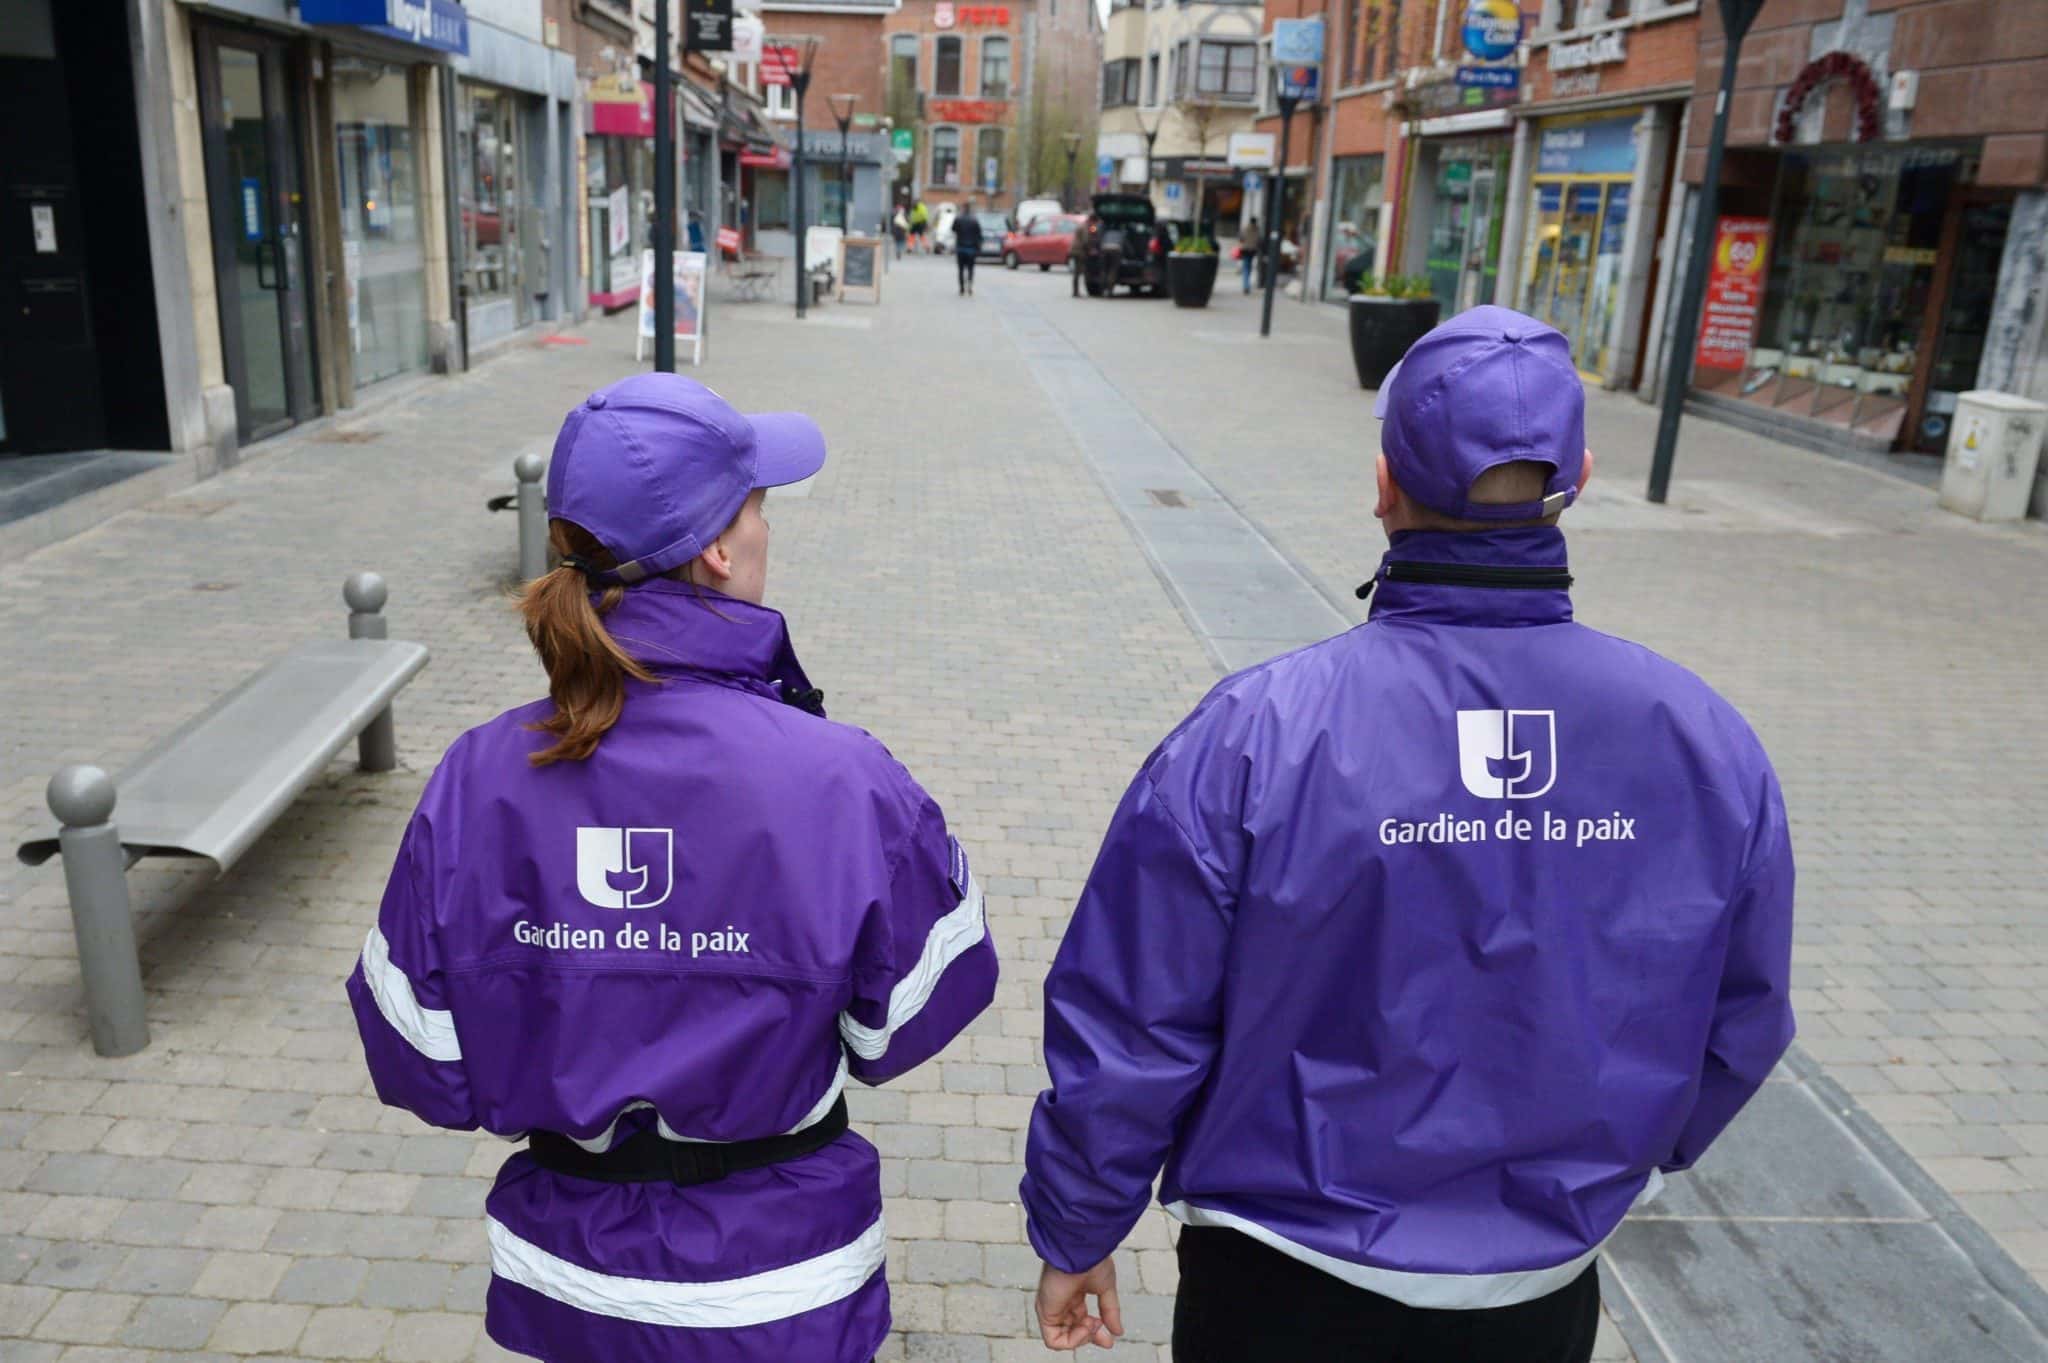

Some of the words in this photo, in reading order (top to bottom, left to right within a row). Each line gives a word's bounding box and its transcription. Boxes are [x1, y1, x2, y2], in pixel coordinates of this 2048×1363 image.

[1379, 812, 1487, 845] Gardien
[1494, 809, 1532, 841] de
[1543, 810, 1567, 841] la
[1575, 810, 1636, 848] paix
[513, 920, 605, 951] Gardien
[615, 922, 650, 950] de
[659, 923, 681, 951] la
[691, 925, 750, 959] paix
